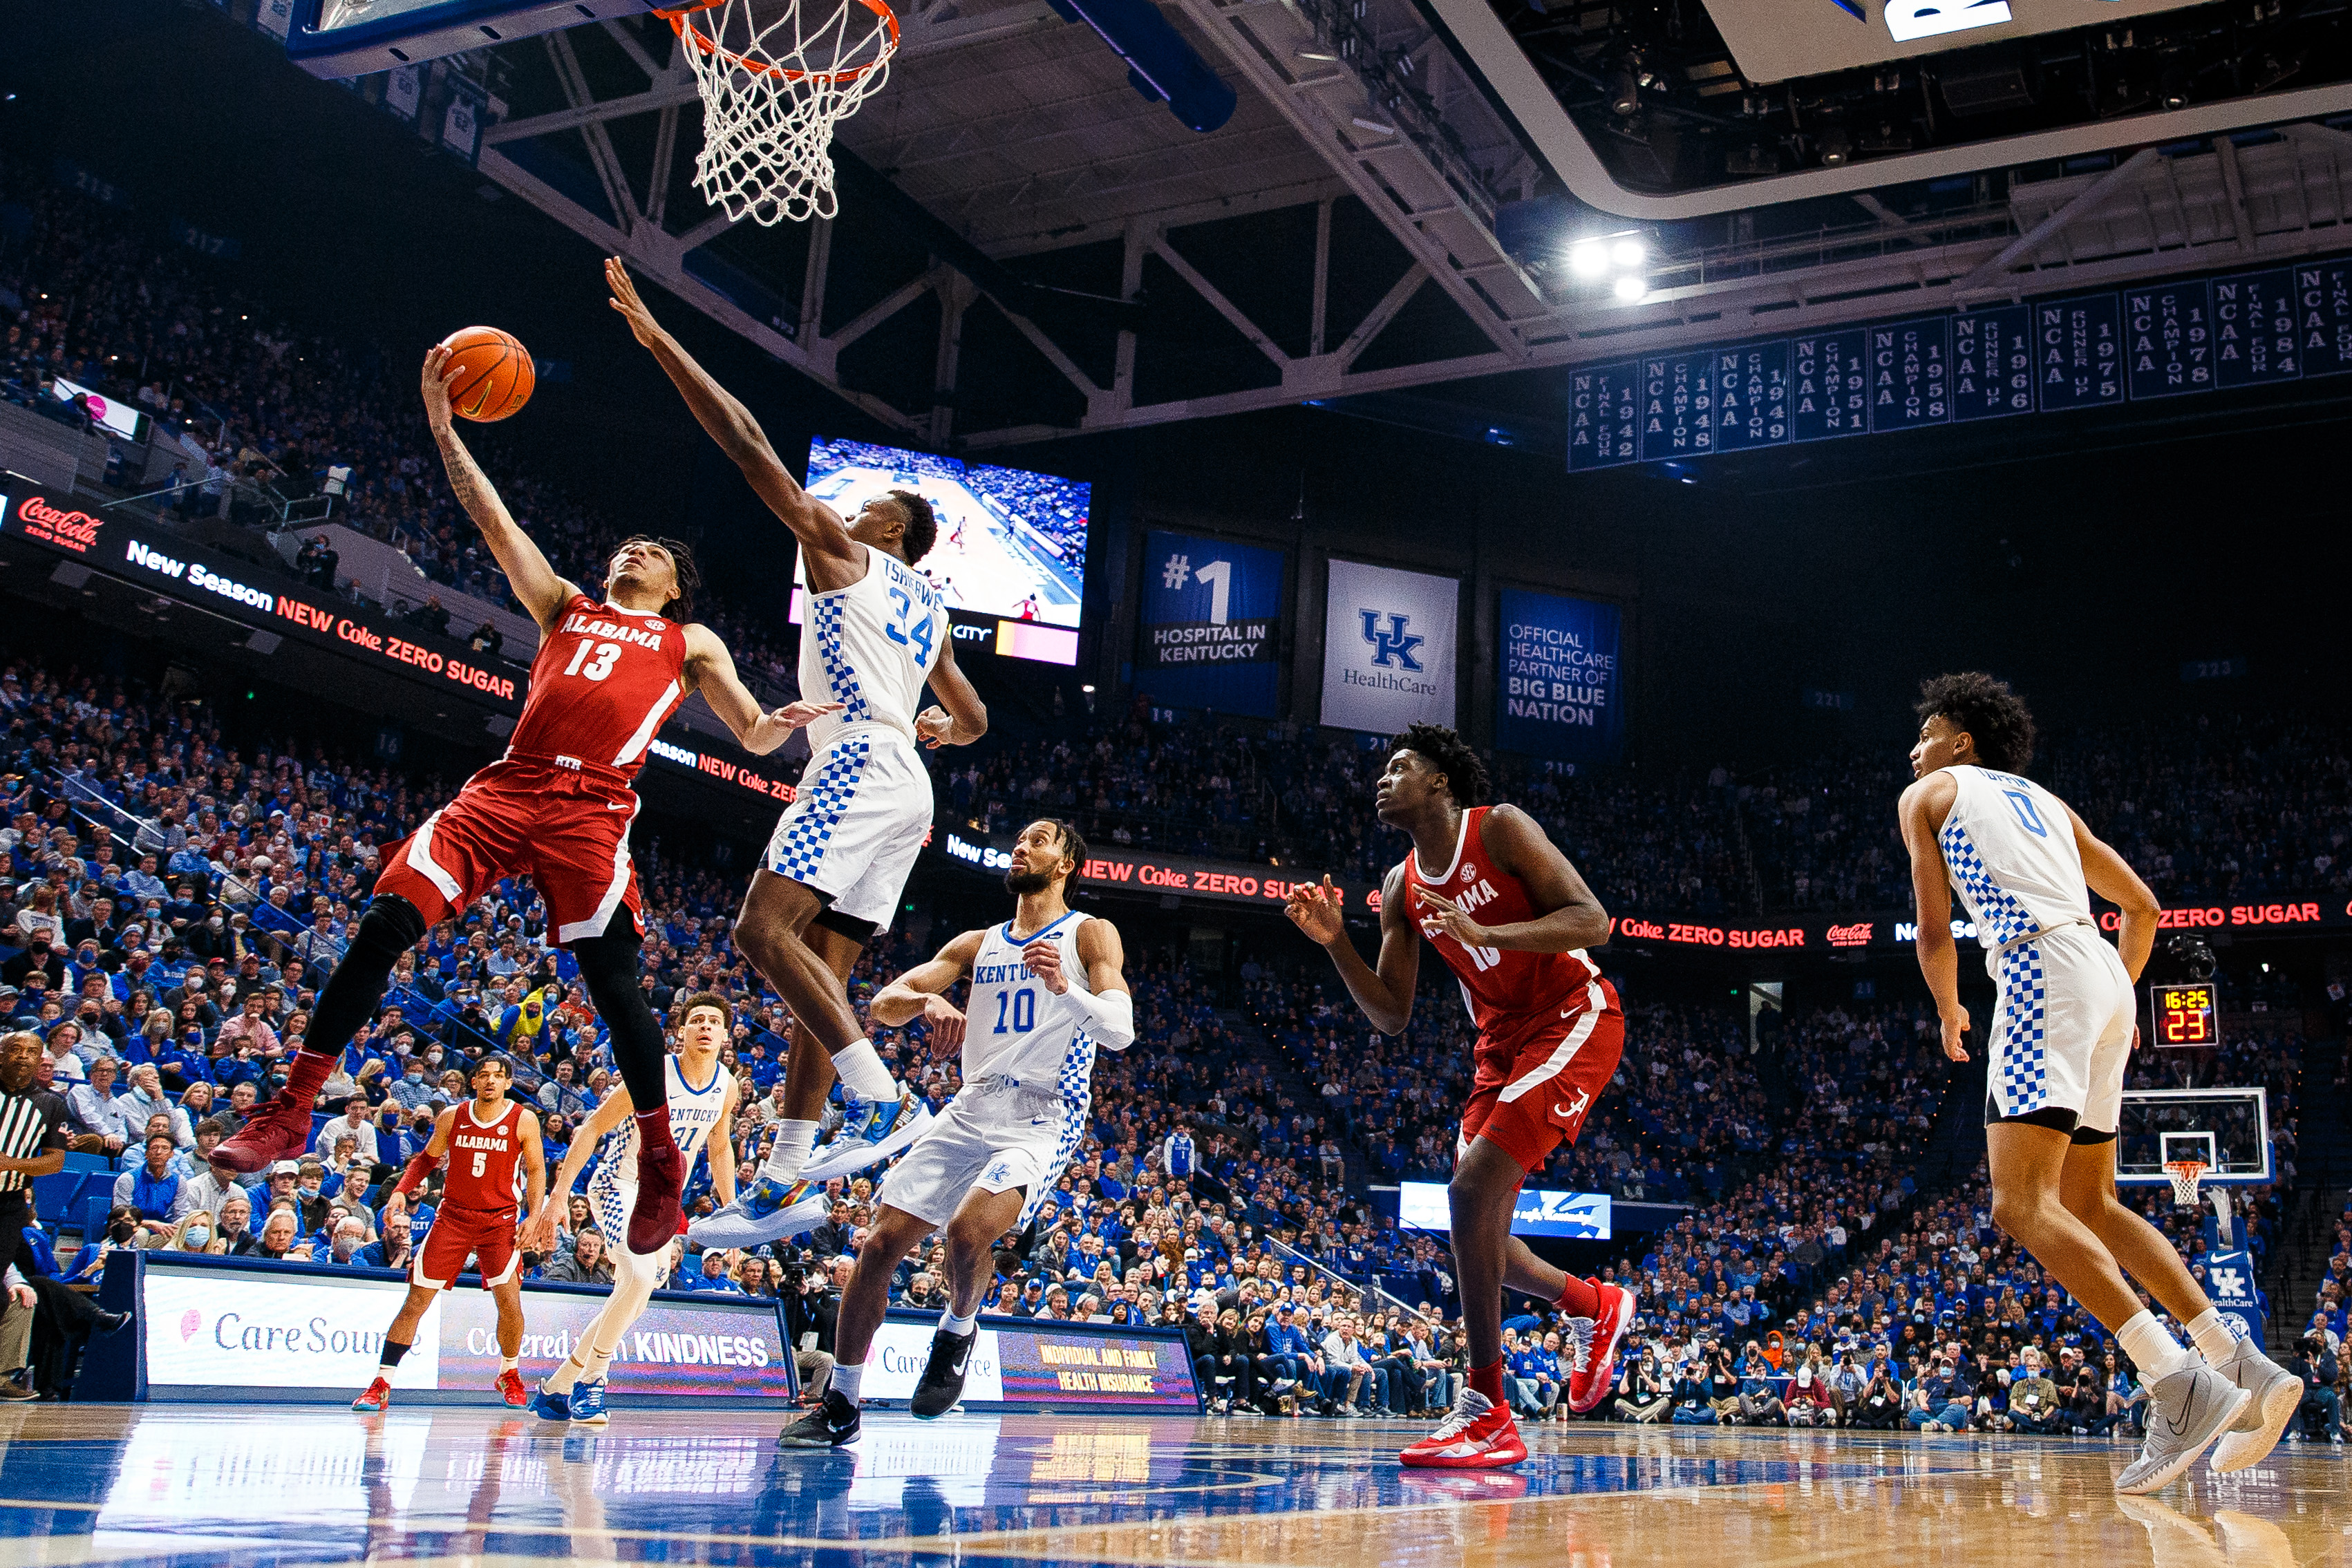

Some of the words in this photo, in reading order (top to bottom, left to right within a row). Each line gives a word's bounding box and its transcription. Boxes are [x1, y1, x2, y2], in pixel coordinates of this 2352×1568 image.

[2217, 283, 2240, 361] NCAA
[2300, 270, 2326, 349] NCAA
[2042, 308, 2064, 384] NCAA
[2131, 295, 2156, 372] NCAA
[2188, 307, 2210, 383] 1978
[2274, 296, 2295, 372] 1984
[1875, 331, 1895, 406] NCAA
[1956, 319, 1977, 395] NCAA
[2010, 334, 2029, 409] 1966
[2097, 322, 2117, 397] 1975
[1720, 354, 1739, 427] NCAA
[1797, 341, 1816, 414] NCAA
[1847, 357, 1864, 428] 1951
[1926, 344, 1946, 417] 1958
[1573, 375, 1591, 446] NCAA
[1646, 361, 1666, 433] NCAA
[1694, 377, 1711, 447] 1948
[1769, 368, 1785, 440] 1949
[1618, 387, 1634, 457] 1942
[18, 497, 104, 544] Coca-Cola
[25, 525, 53, 540] ZERO
[1163, 554, 1230, 625] #1
[126, 540, 185, 577] New
[188, 564, 274, 612] Season
[277, 596, 334, 632] NEW
[386, 637, 443, 672] ZERO
[446, 661, 514, 700] SUGAR
[560, 614, 662, 652] ALABAMA
[885, 587, 933, 669] 34
[953, 625, 992, 641] CITY
[1154, 626, 1242, 644] HOSPITAL
[1246, 625, 1266, 639] IN
[1509, 624, 1583, 648] OFFICIAL
[1160, 643, 1259, 662] KENTUCKY
[1359, 608, 1424, 673] UK
[1509, 642, 1613, 670] HEALTHCARE
[563, 639, 622, 681] 13
[1509, 659, 1581, 682] PARTNER
[1585, 669, 1608, 686] OF
[1343, 669, 1436, 695] HealthCare
[1509, 677, 1545, 698] BIG
[1552, 683, 1605, 707] BLUE
[1508, 698, 1593, 726] NATION
[555, 755, 582, 771] RTR
[648, 739, 697, 767] eason
[699, 754, 737, 781] NEW
[771, 781, 798, 802] ZER
[2002, 789, 2047, 838] 0
[947, 834, 981, 862] New
[1194, 871, 1258, 896] ZERO
[1462, 864, 1475, 882] SEC
[1827, 923, 1873, 941] Coca-Cola
[2157, 907, 2224, 928] ZERO
[2231, 902, 2320, 925] SUGAR
[1668, 923, 1724, 945] ZERO
[1728, 929, 1804, 947] SUGAR
[975, 963, 1035, 984] KENTU
[993, 988, 1035, 1035] 10
[2165, 990, 2208, 1009] 16:25
[2167, 1010, 2204, 1040] 23
[670, 1108, 718, 1122] ENTUCKY
[895, 1109, 914, 1128] PHIL
[455, 1135, 508, 1152] ALABAMA
[673, 1126, 699, 1152] 31
[471, 1152, 487, 1178] 5
[2210, 1267, 2246, 1297] UK
[215, 1313, 421, 1356] CareSoure
[467, 1327, 570, 1358] Coered
[634, 1331, 769, 1368] KINDNESS
[883, 1346, 991, 1377] Carerce
[1040, 1345, 1101, 1366] INDIVIDUAL
[1102, 1348, 1122, 1367] AND
[1122, 1349, 1158, 1368] FAMILY
[1057, 1371, 1098, 1391] HEALTH
[1098, 1372, 1155, 1393] INSURANCE
